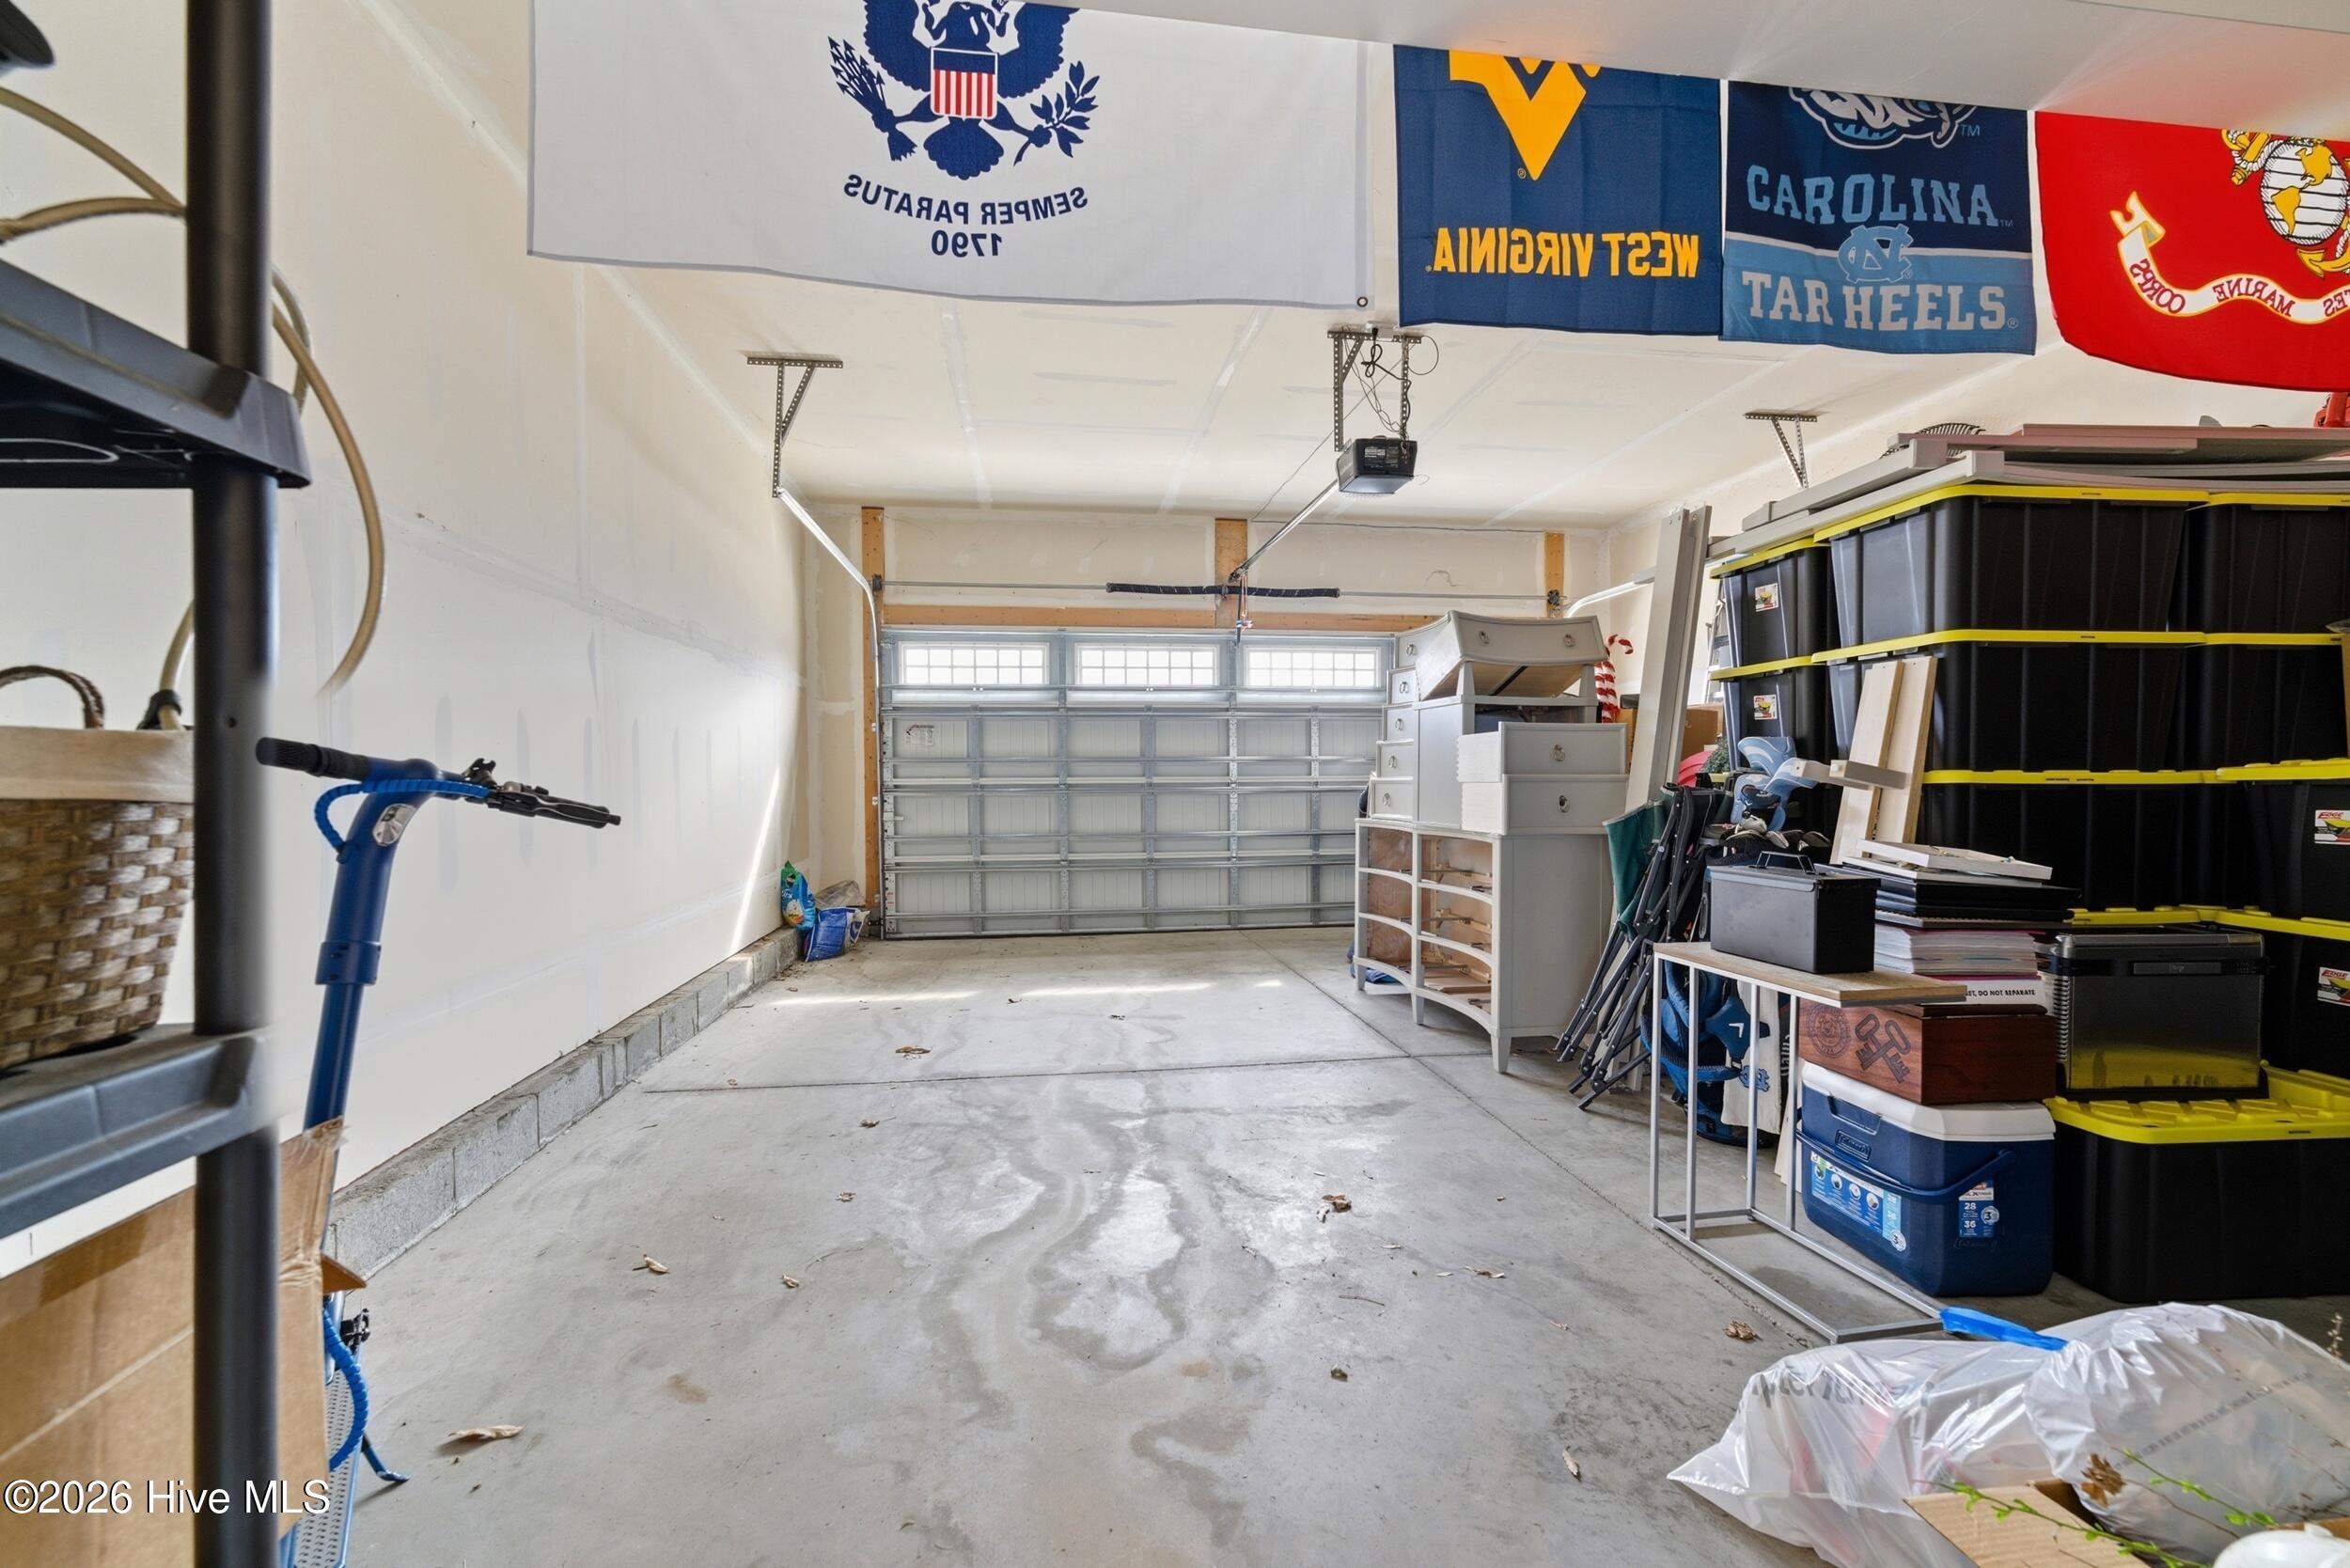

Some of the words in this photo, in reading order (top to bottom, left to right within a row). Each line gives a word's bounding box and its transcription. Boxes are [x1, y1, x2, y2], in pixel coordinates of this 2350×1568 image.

[1747, 164, 1999, 227] CAROLINA
[1742, 271, 1833, 325] TAR
[1842, 284, 2006, 332] HEELS
